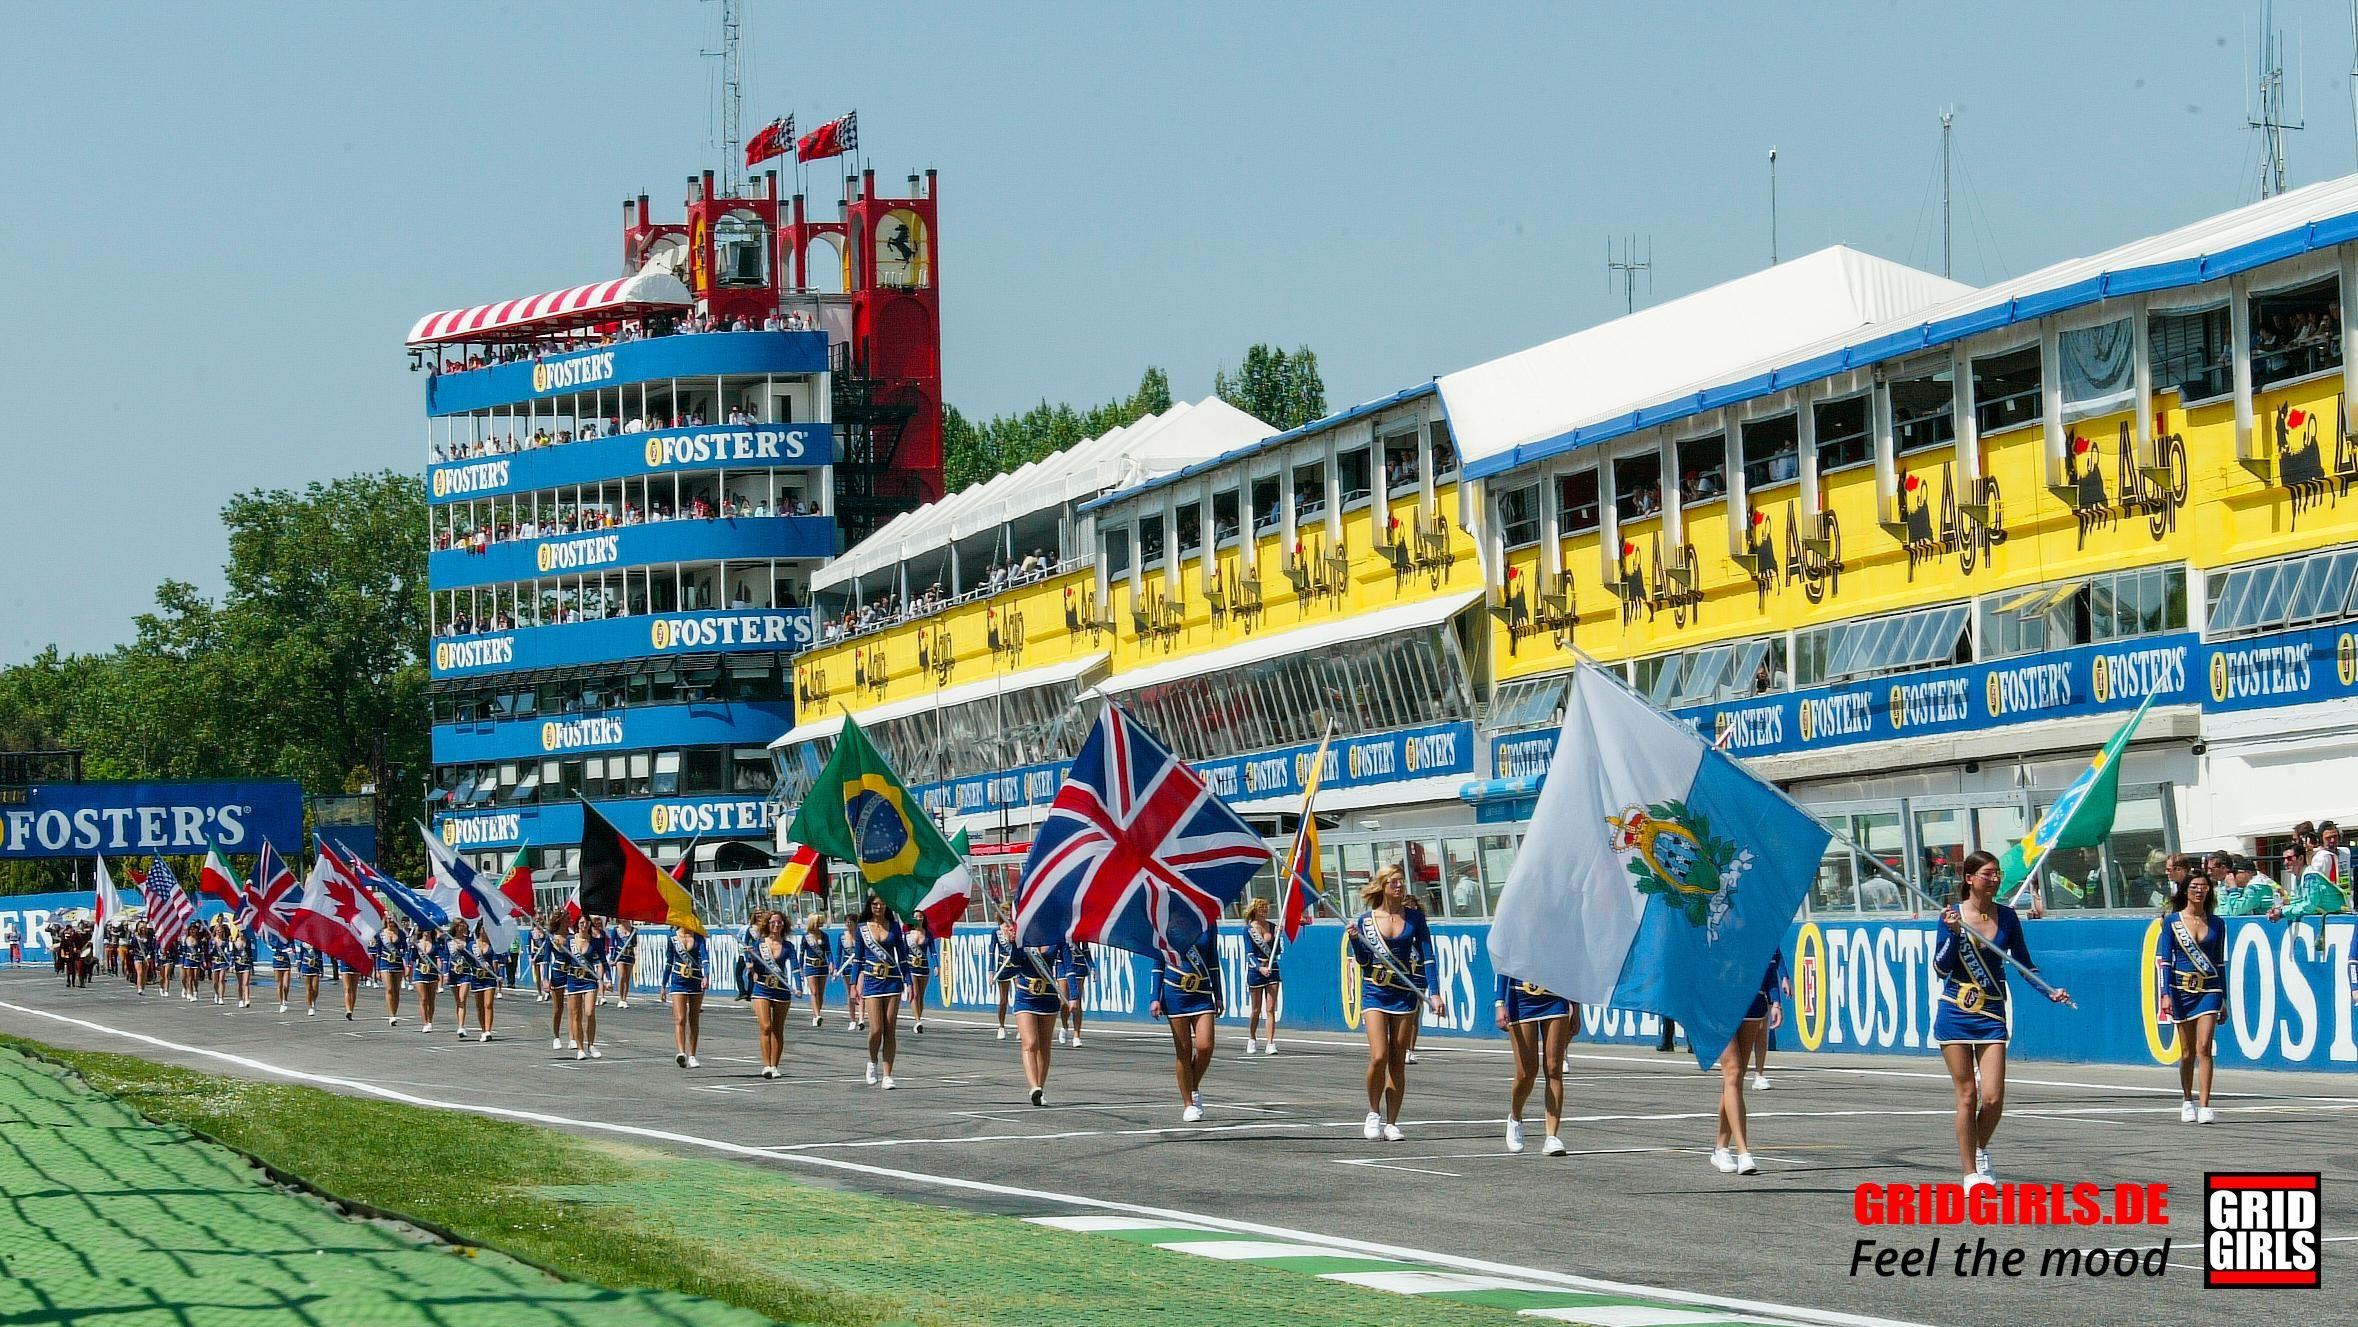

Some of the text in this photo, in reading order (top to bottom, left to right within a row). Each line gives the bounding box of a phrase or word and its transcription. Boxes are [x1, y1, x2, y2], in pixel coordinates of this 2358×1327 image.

[546, 352, 614, 389] FOSTER'S
[662, 431, 805, 464] FOSTER'S
[445, 460, 510, 494] FOSTER'S
[550, 535, 619, 569] FOSTER'S
[668, 615, 812, 647] FOSTER'S
[448, 638, 514, 667] FOSTER'S
[2108, 646, 2186, 699] FOSTER'S
[2226, 642, 2311, 698] FOSTER'S
[1901, 677, 1968, 726] FOSTER'S
[2000, 662, 2071, 713] FOSTER'S
[555, 716, 623, 747] FOSTER'S
[1811, 692, 1872, 738] FOSTER'S
[454, 814, 520, 844] FOSTER'S
